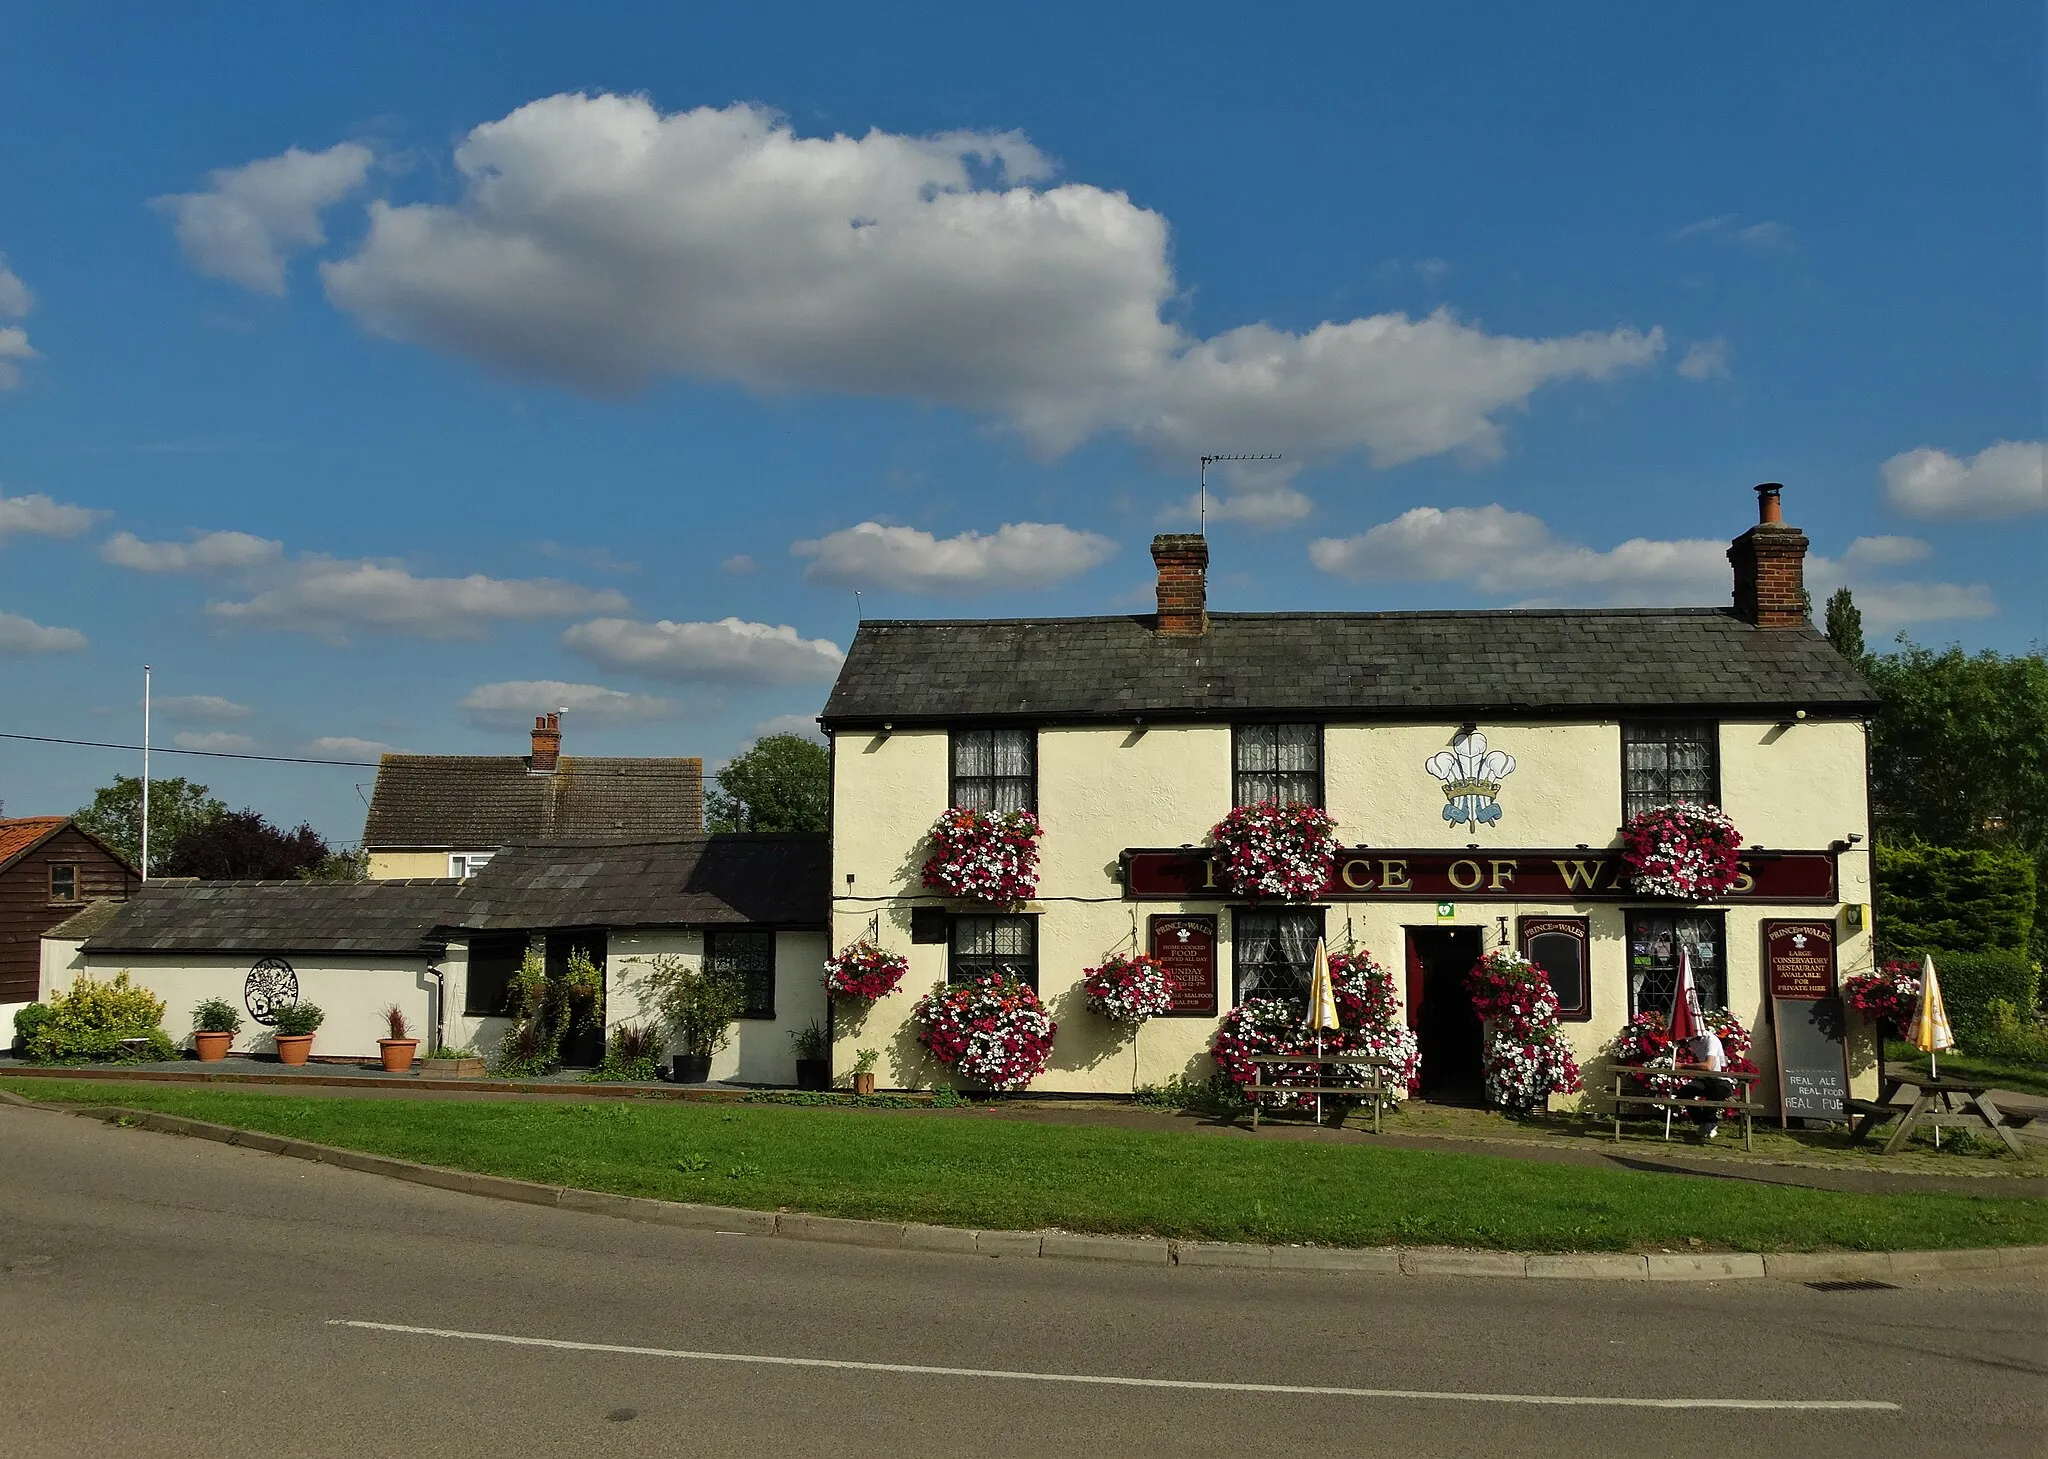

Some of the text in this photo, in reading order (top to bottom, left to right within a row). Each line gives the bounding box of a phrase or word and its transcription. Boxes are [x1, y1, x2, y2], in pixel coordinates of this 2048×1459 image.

[1203, 858, 1412, 892] PCE
[1448, 859, 1518, 891] OF
[1155, 922, 1182, 935] PRINCE
[1188, 922, 1212, 935] WALES
[1524, 923, 1553, 937] PRINCE
[1559, 923, 1585, 937] WALES
[1769, 926, 1798, 940] PRINCE
[1803, 926, 1831, 941] WALES
[1169, 974, 1205, 982] UNCHES
[1789, 1076, 1836, 1086] REAL ALE
[1798, 1086, 1844, 1097] REAL FOOD
[1784, 1096, 1844, 1110] REAL PUB
